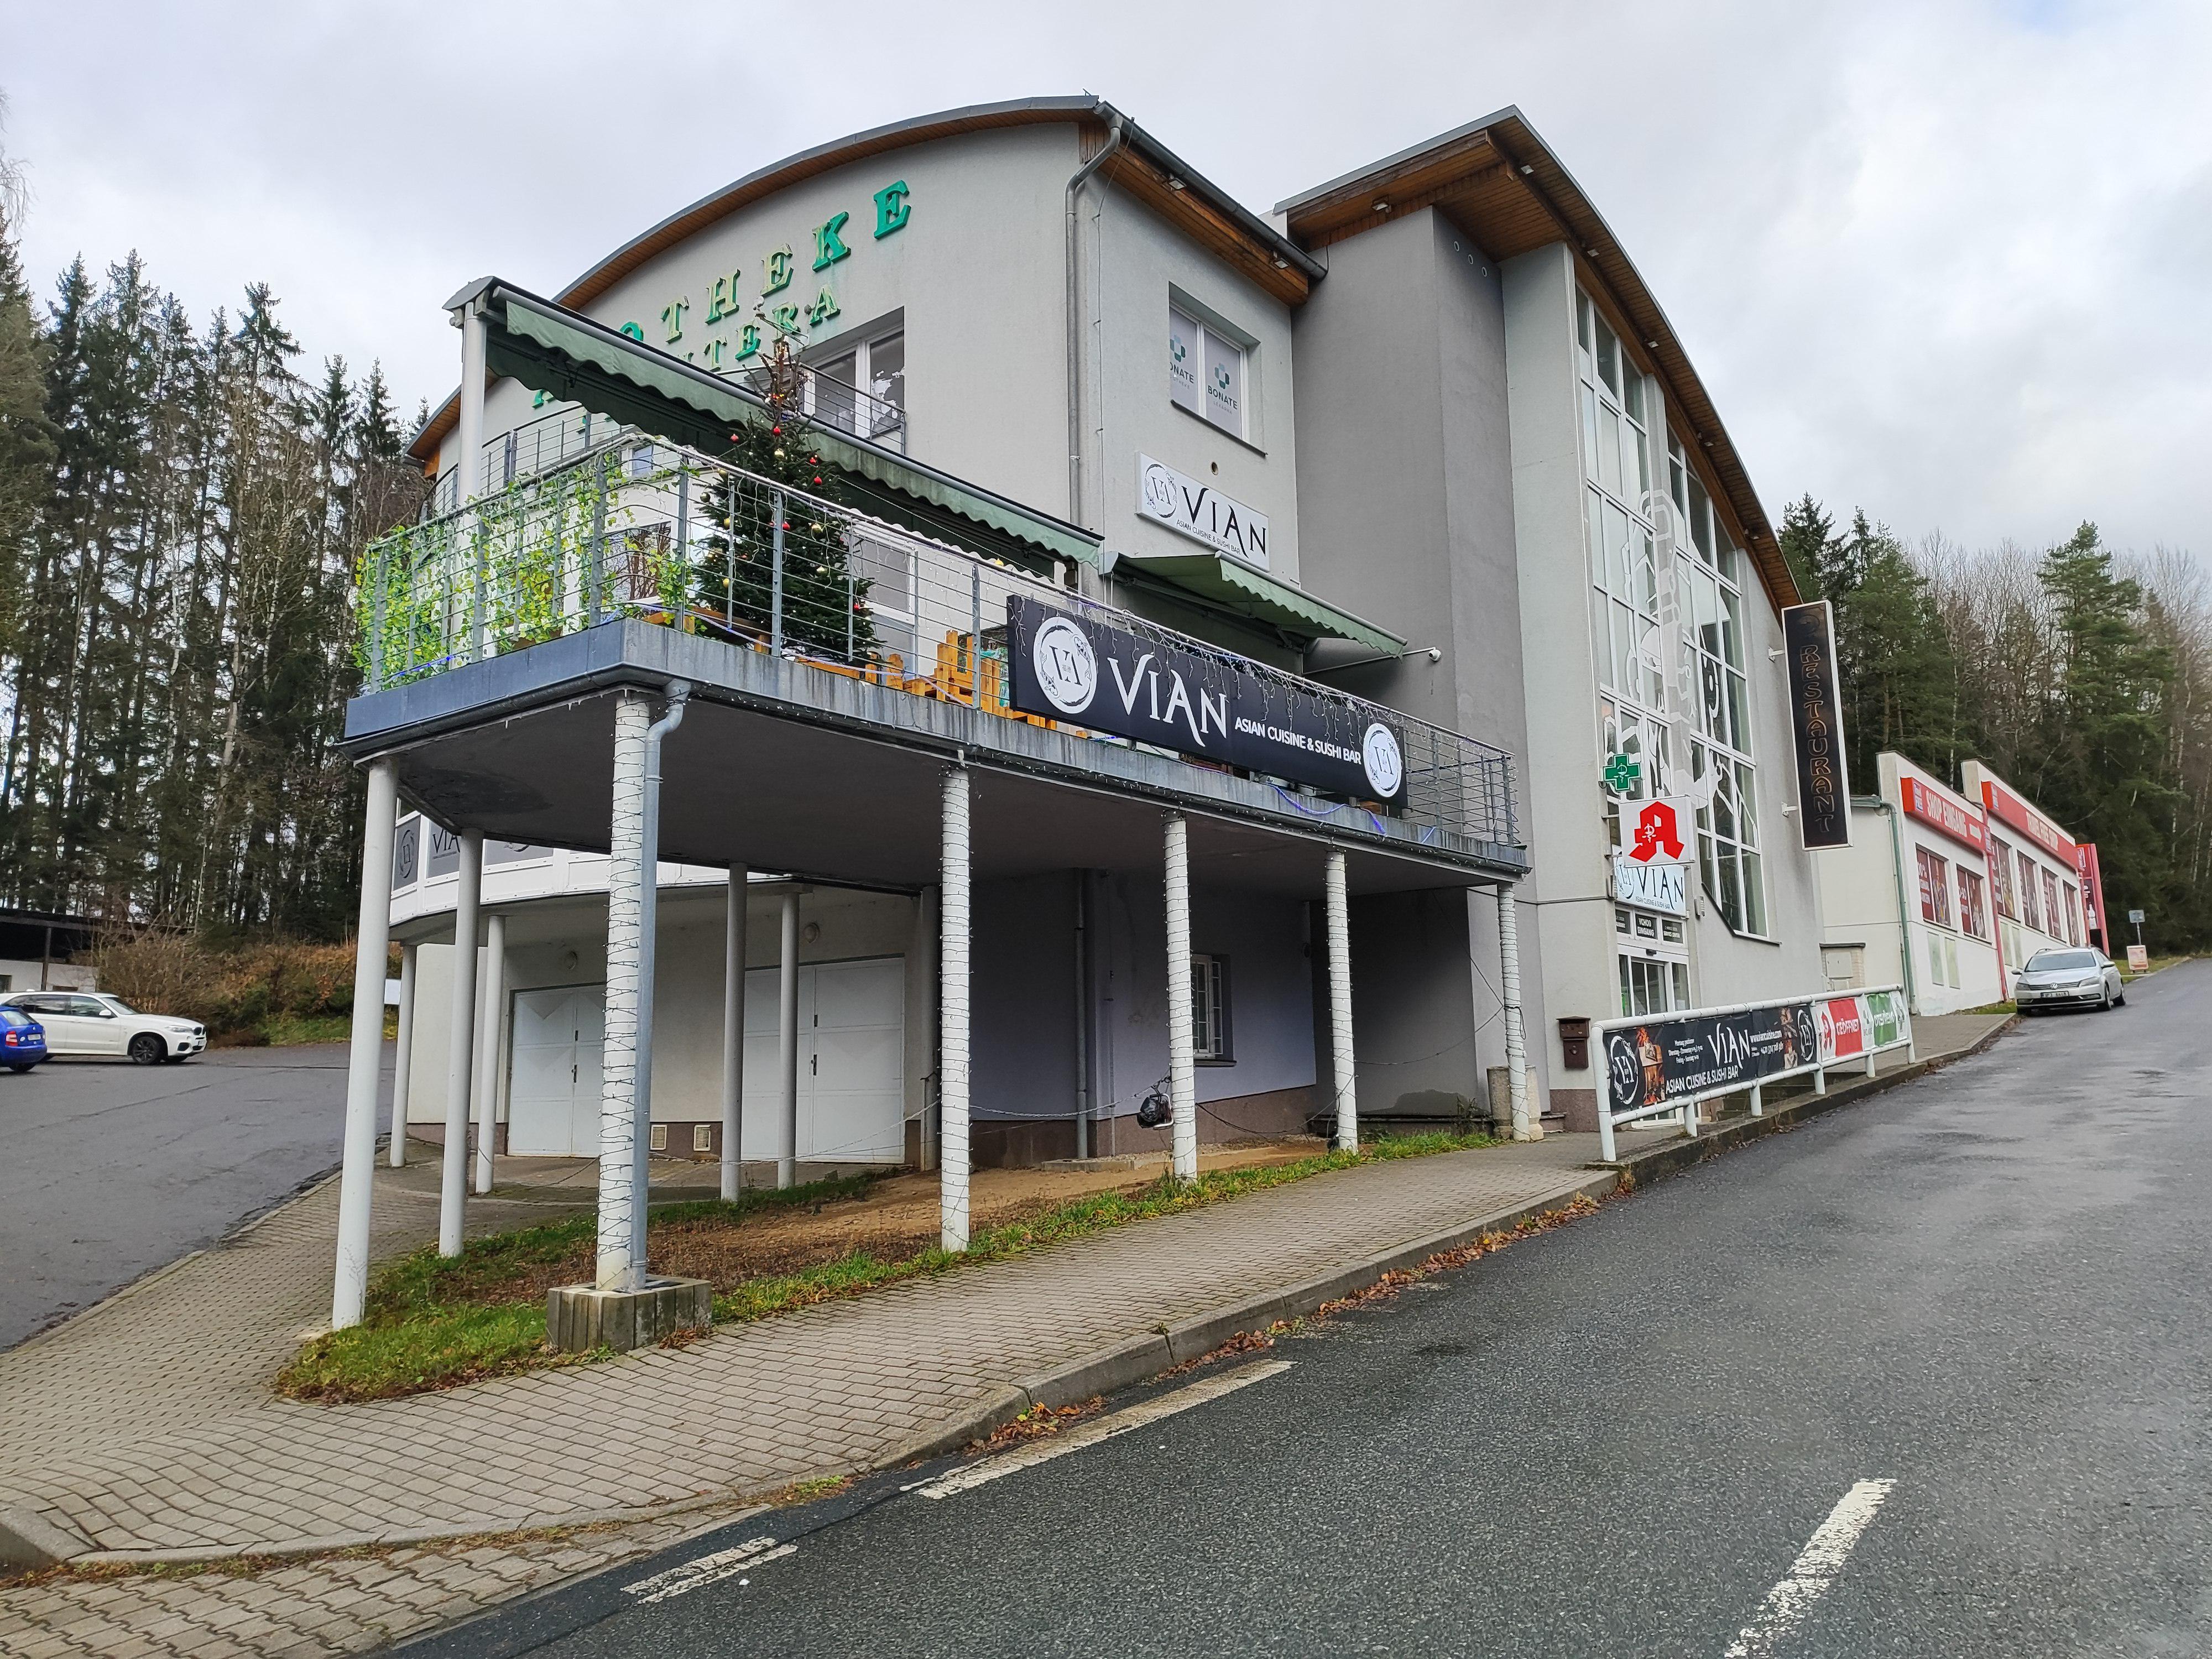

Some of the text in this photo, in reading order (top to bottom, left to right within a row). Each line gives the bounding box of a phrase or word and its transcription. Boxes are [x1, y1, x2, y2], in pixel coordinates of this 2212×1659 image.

[1170, 362, 1194, 384] ONATE
[1208, 385, 1238, 410] BONATE
[1176, 519, 1191, 531] ASIAN
[1192, 526, 1212, 541] CUISINE
[1217, 538, 1230, 550] SUSHI
[1231, 545, 1241, 555] BAR
[1181, 486, 1266, 559] VIAN
[1107, 653, 1228, 747] VIAN
[1234, 717, 1362, 765] ASIAN CUISINE & SUSHI BAR
[1799, 644, 1835, 832] RESTAURANT
[1926, 790, 1942, 823] SHOP
[432, 828, 461, 854] VIA
[1636, 866, 1684, 911] VIAN
[1637, 926, 1655, 937] EINGANG
[1638, 917, 1652, 927] VCHOD
[1707, 1023, 1750, 1070] VIAN
[1666, 1065, 1739, 1094] ASIAN CUISINE & SUSHI BAR
